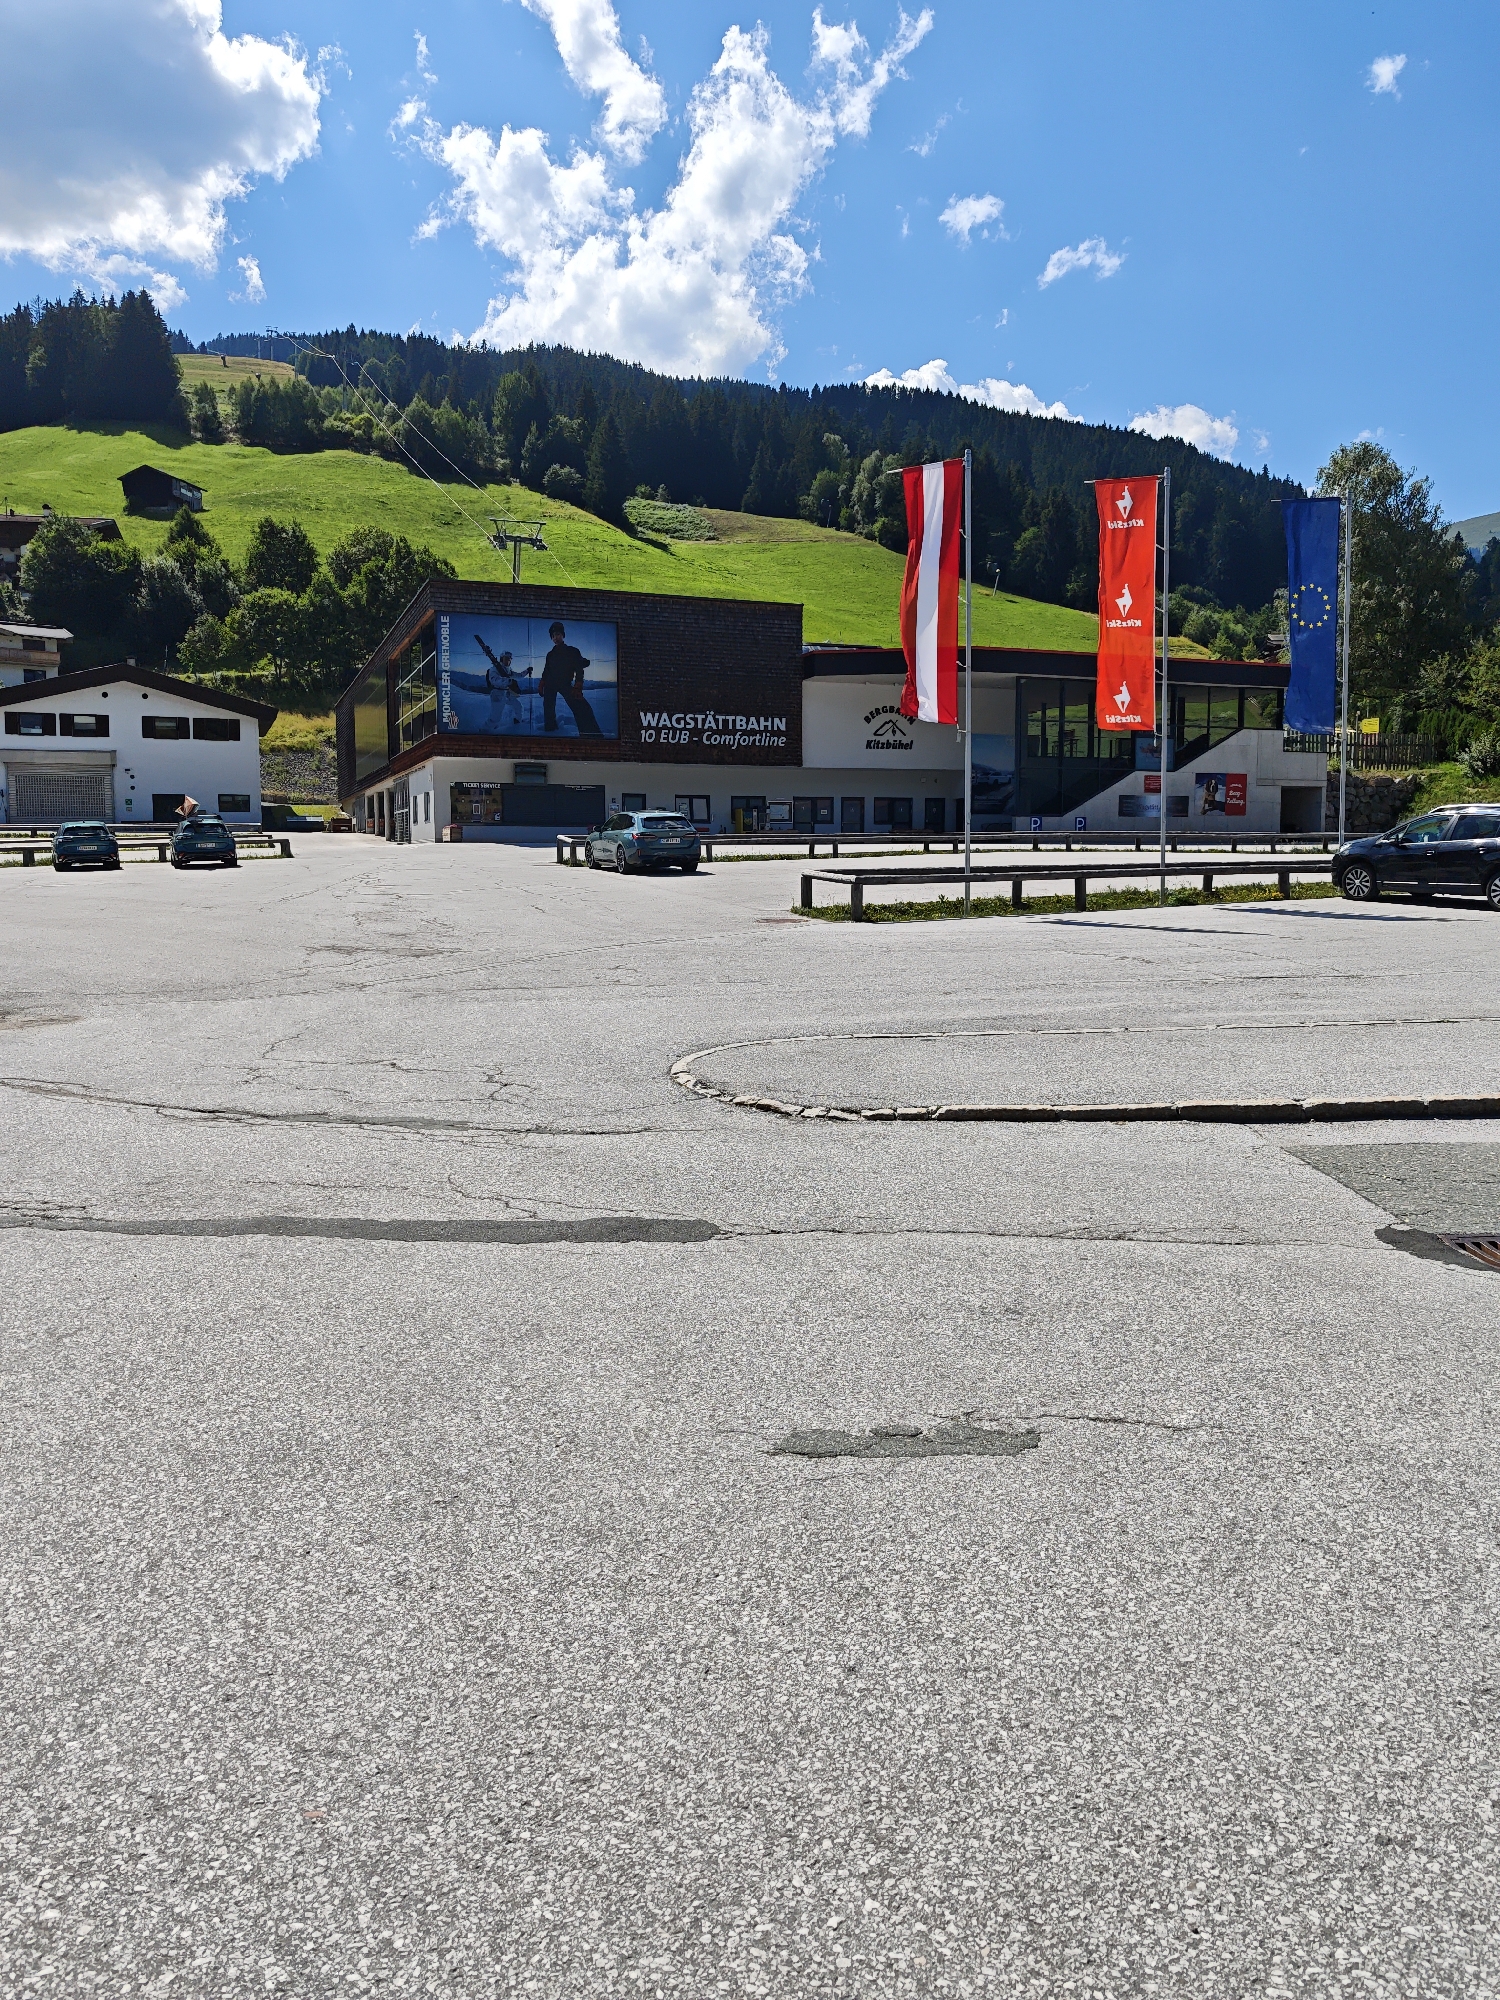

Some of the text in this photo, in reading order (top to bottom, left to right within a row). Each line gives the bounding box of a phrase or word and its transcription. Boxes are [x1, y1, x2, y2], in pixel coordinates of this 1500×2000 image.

[440, 615, 451, 723] MONCLER GRENOBLE
[639, 710, 787, 731] WAGSTÄTTBAHN
[640, 729, 656, 743] 10
[659, 730, 690, 744] EUB
[702, 731, 787, 750] Comfortline
[865, 739, 914, 750] Kitzbühel
